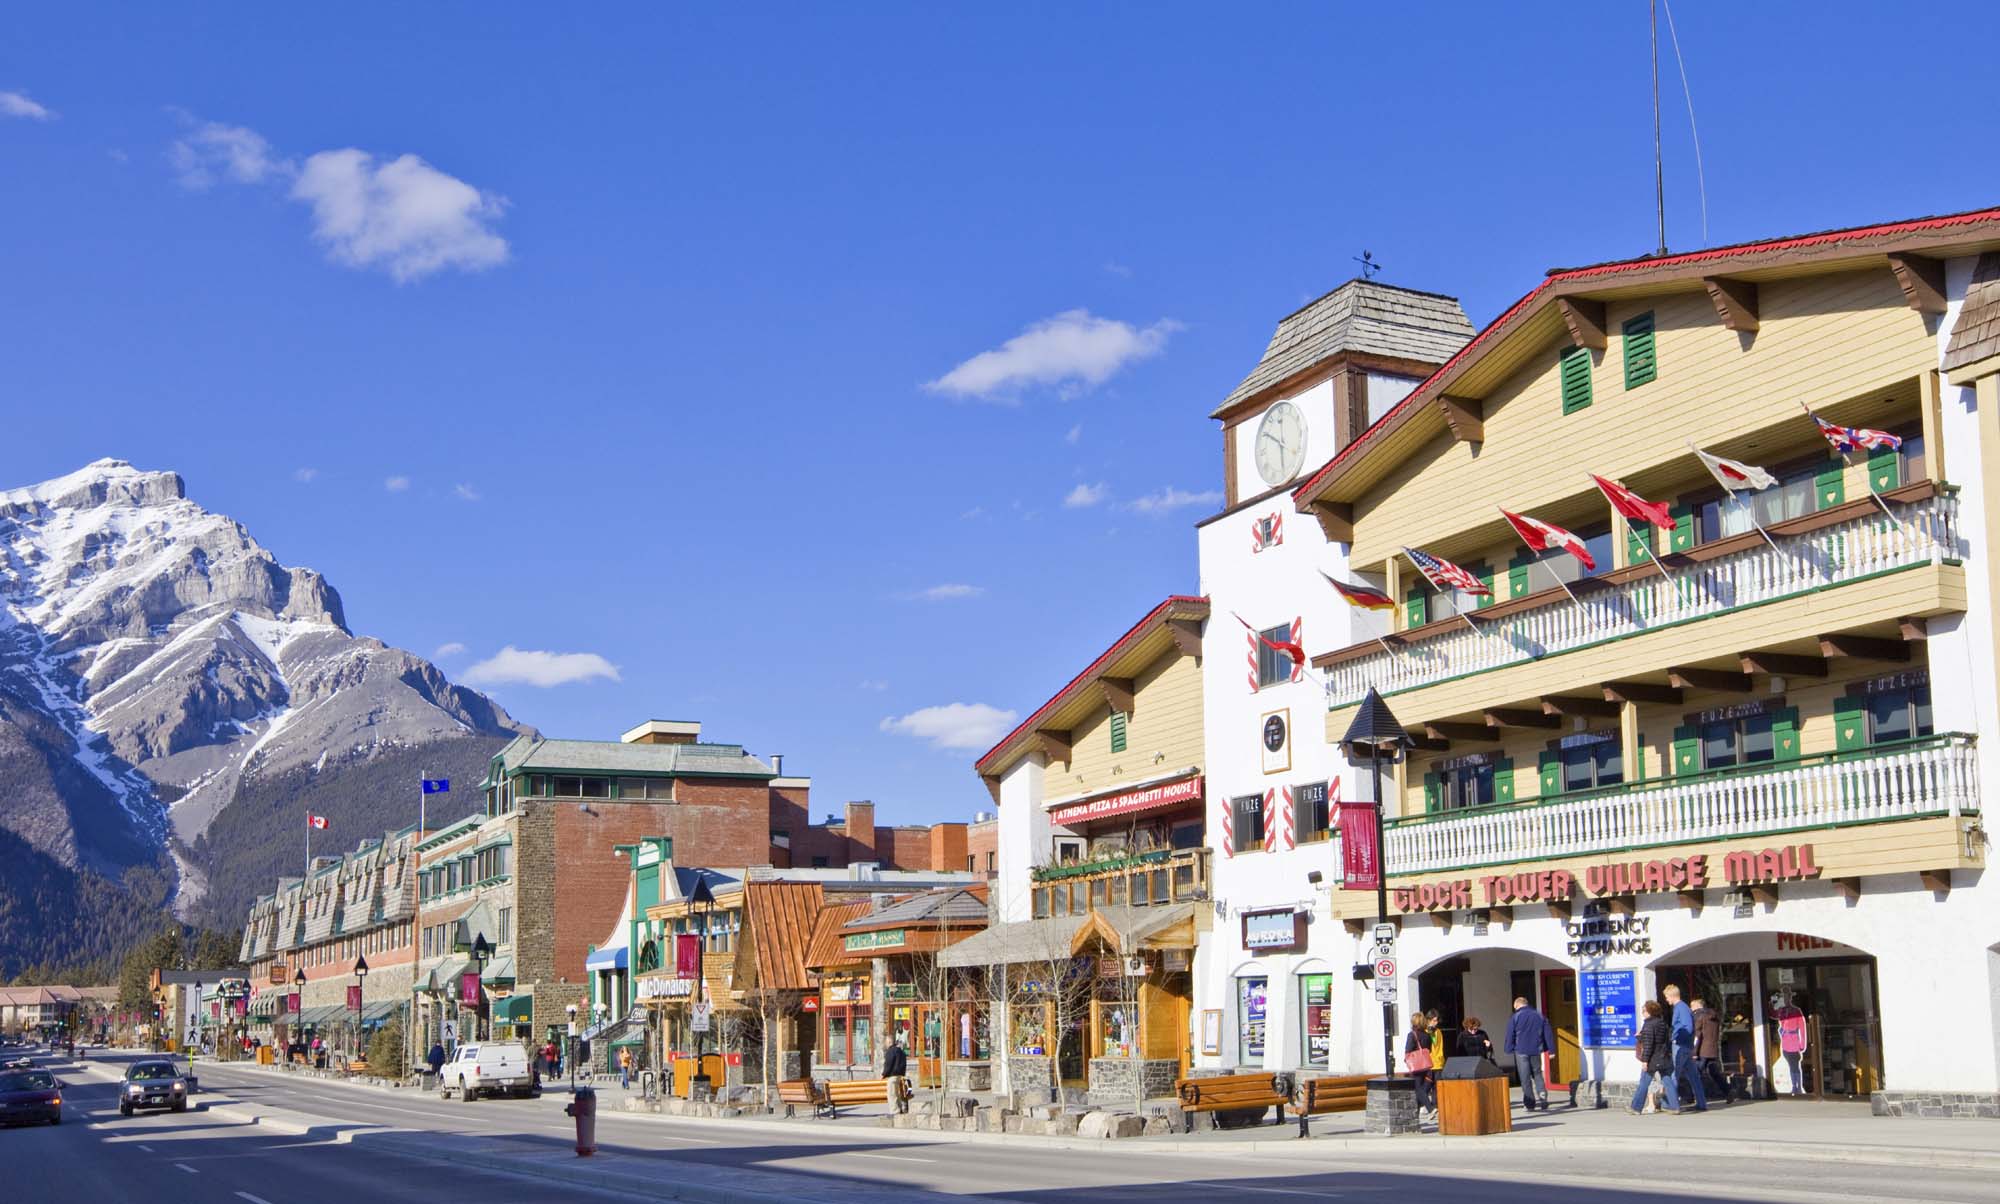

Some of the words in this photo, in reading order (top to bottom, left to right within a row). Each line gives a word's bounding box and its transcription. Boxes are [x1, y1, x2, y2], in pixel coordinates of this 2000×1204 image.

[1867, 673, 1906, 692] FUZE
[1701, 706, 1733, 722] FUZE
[1058, 806, 1088, 819] ATHENA
[1089, 800, 1110, 812] PIZZA
[1112, 800, 1118, 808] &
[1119, 788, 1162, 808] SPAGHETTI
[1163, 781, 1192, 797] HOUSE
[1303, 787, 1322, 800] FUZE
[1241, 799, 1259, 811] FUZE
[1393, 880, 1472, 912] CLOCK
[1479, 869, 1572, 906] TOWER
[1586, 855, 1706, 895] VILLAGE
[1724, 844, 1818, 881] MALL
[1566, 917, 1650, 938] CURRENCY
[1567, 938, 1652, 957] EXCHANGE
